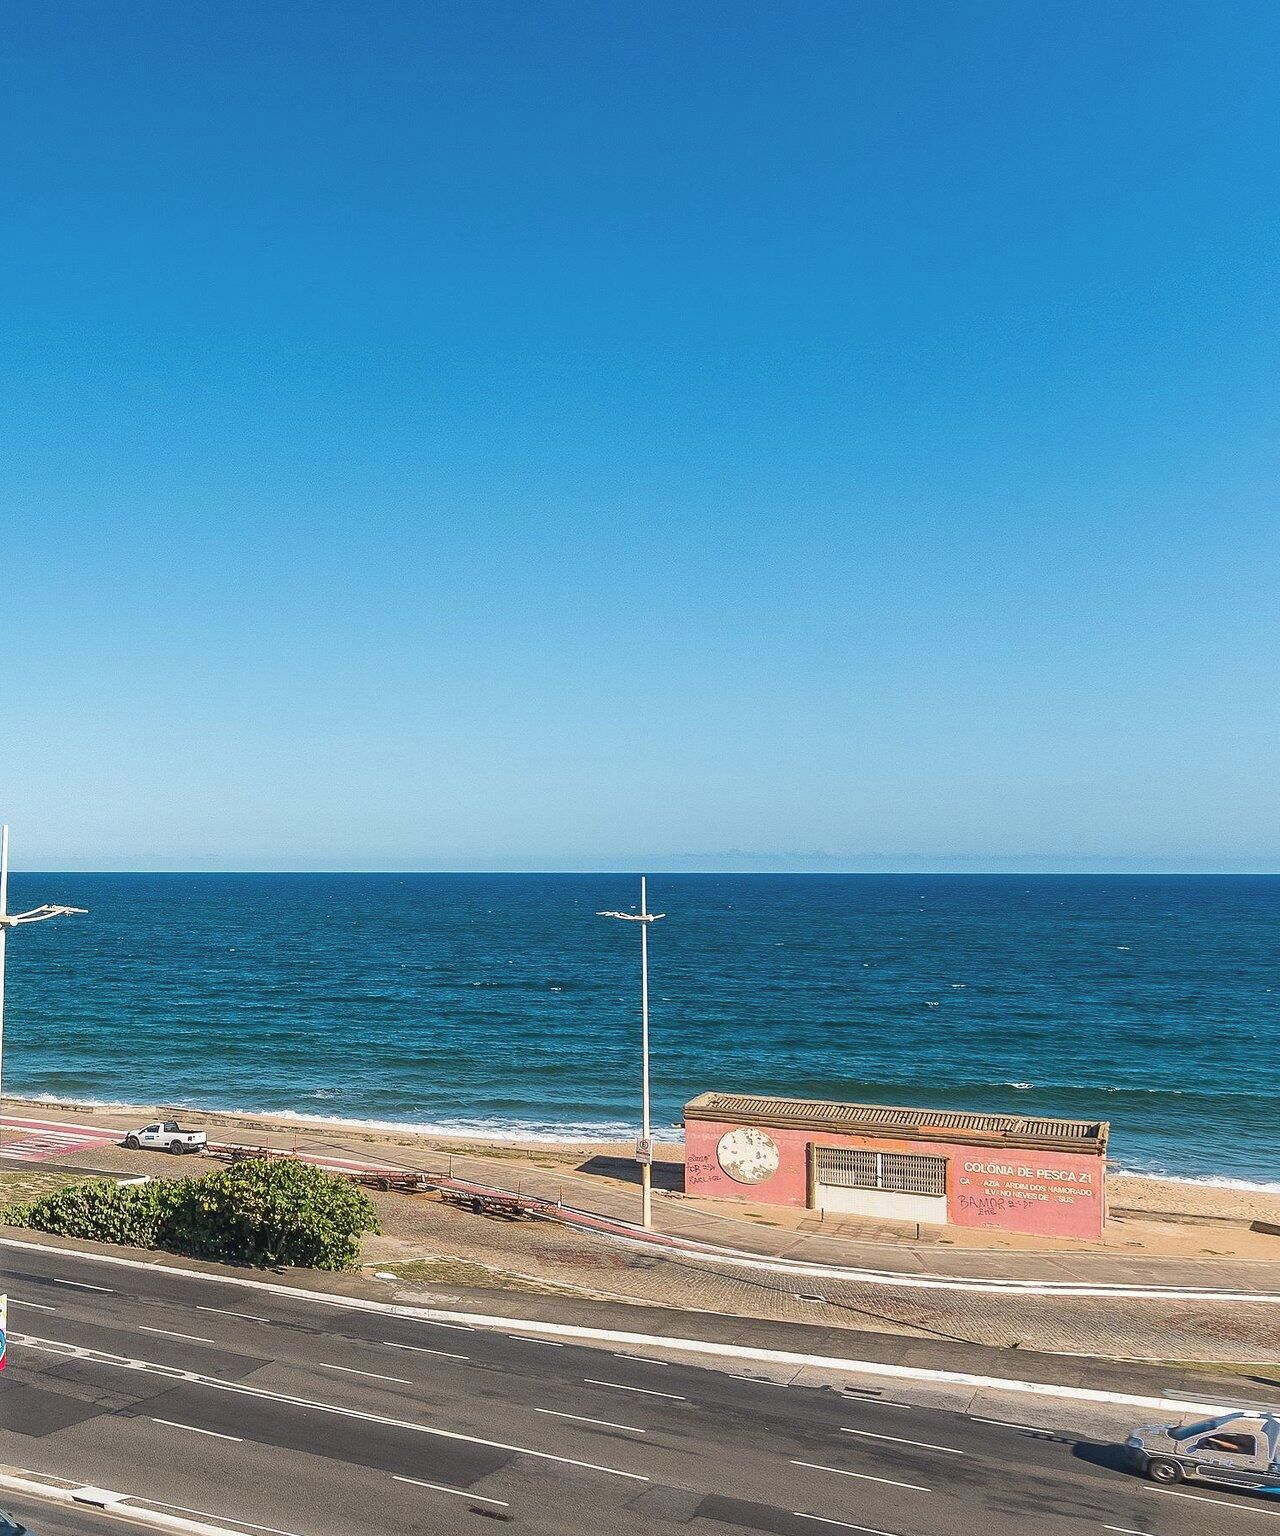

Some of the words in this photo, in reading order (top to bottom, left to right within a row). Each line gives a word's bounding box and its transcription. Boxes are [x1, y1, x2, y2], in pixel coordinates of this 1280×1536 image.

[1017, 1167, 1034, 1178] DE
[1036, 1169, 1076, 1182] PESCA
[1012, 1192, 1037, 1200] NEVES
